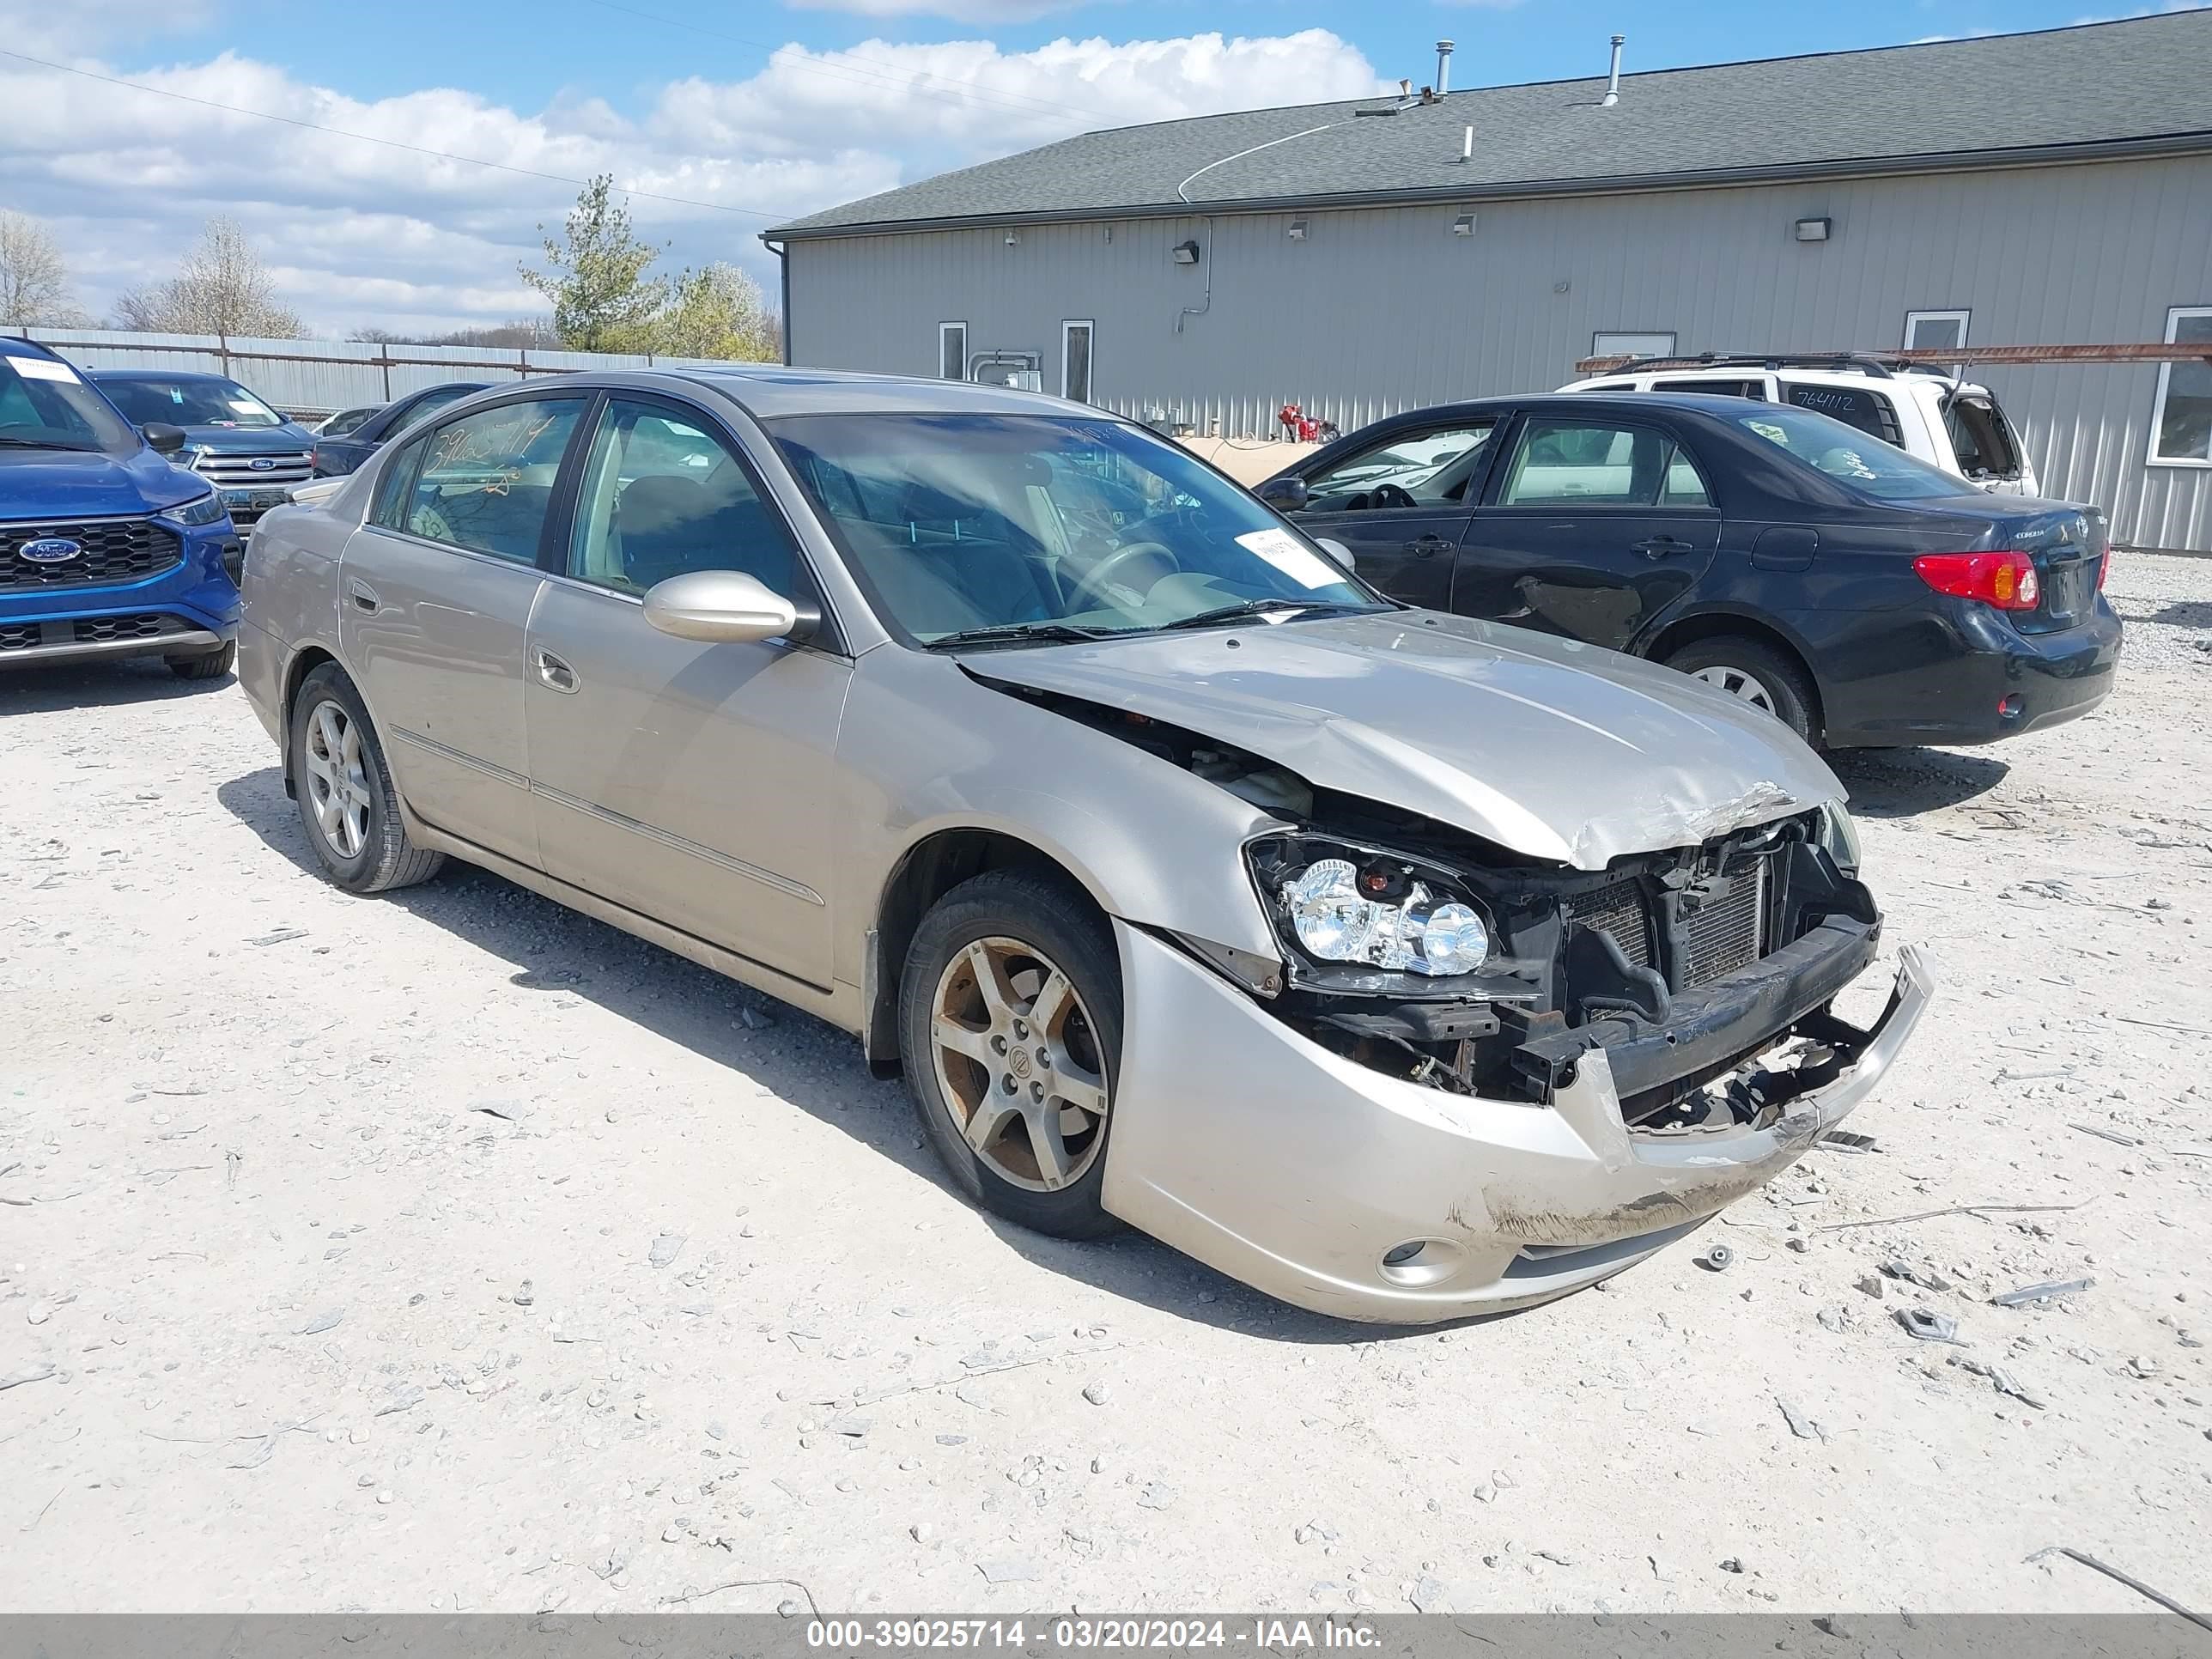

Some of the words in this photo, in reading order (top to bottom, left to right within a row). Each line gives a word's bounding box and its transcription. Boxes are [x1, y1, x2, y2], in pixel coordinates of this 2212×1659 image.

[1798, 392, 1856, 410] 764112
[2014, 530, 2045, 539] COROLLA
[34, 544, 69, 557] Ford
